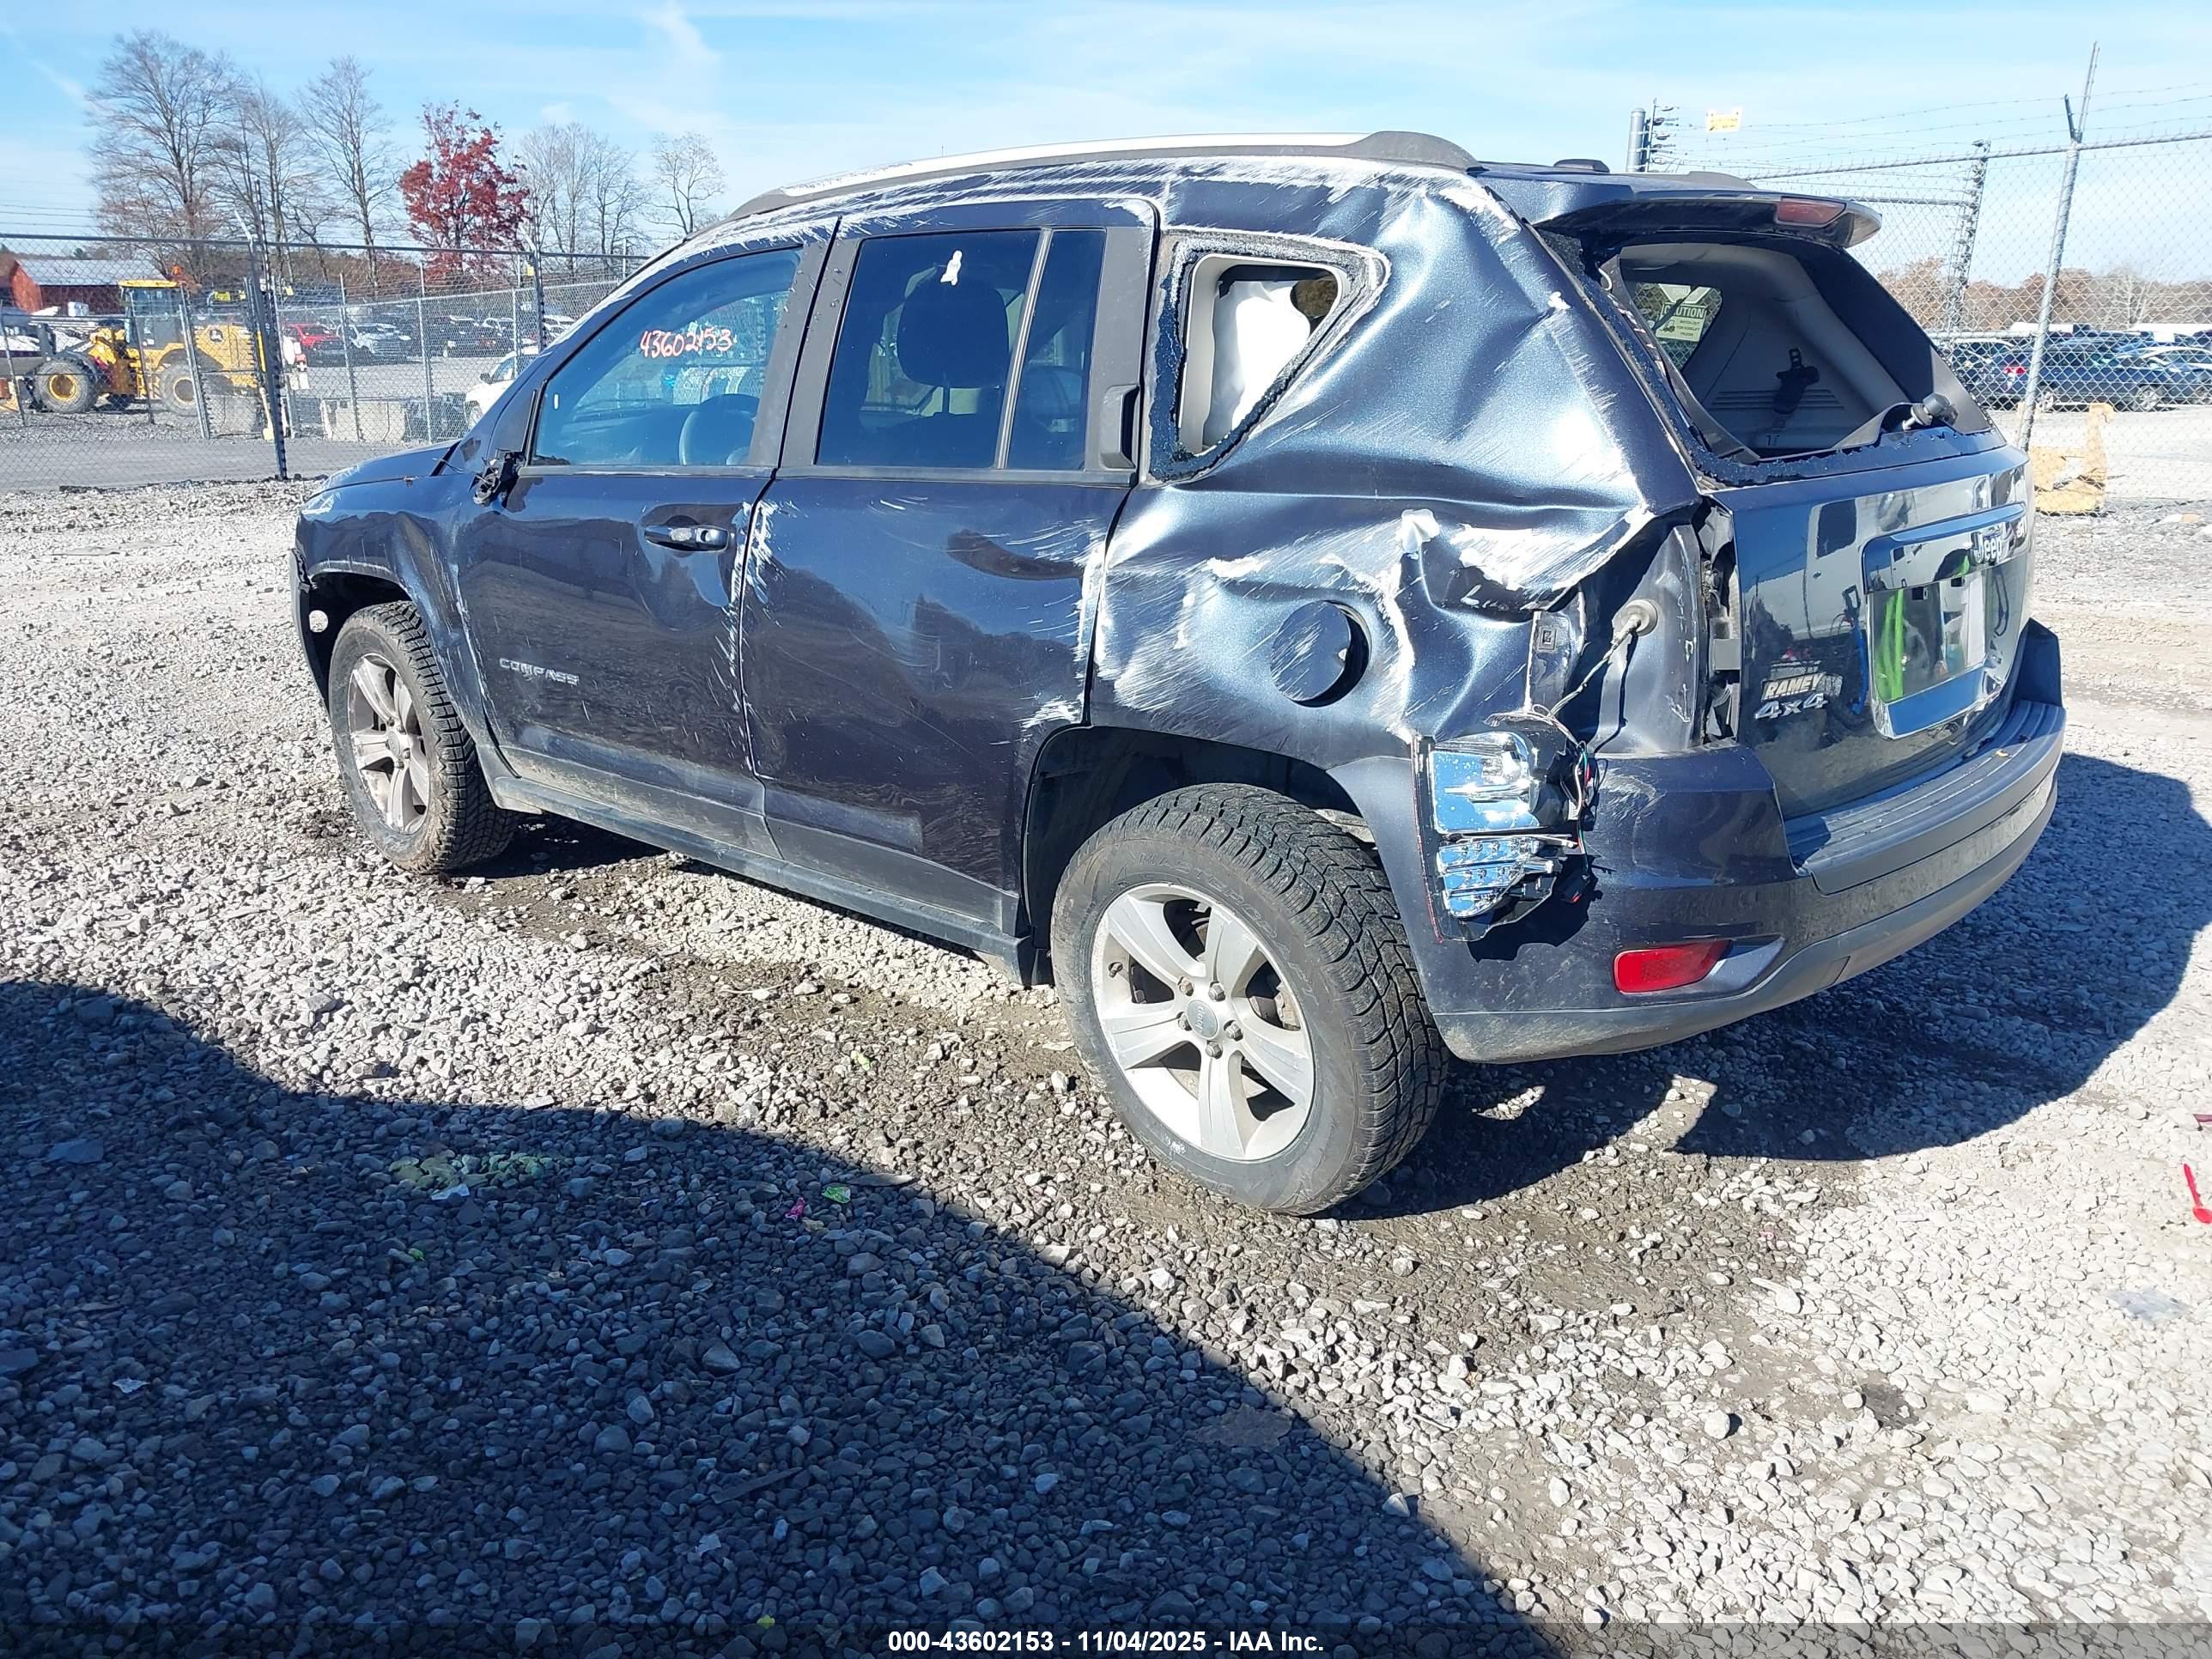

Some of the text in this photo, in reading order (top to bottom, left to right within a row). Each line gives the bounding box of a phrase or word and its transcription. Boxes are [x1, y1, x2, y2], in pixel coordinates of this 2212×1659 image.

[1663, 305, 1705, 319] CUTION
[640, 326, 733, 359] 43602153
[1973, 532, 2002, 564] Jeep
[499, 658, 580, 687] COMPASS
[1763, 672, 1826, 701] RAMEY
[1754, 692, 1829, 720] 4x4
